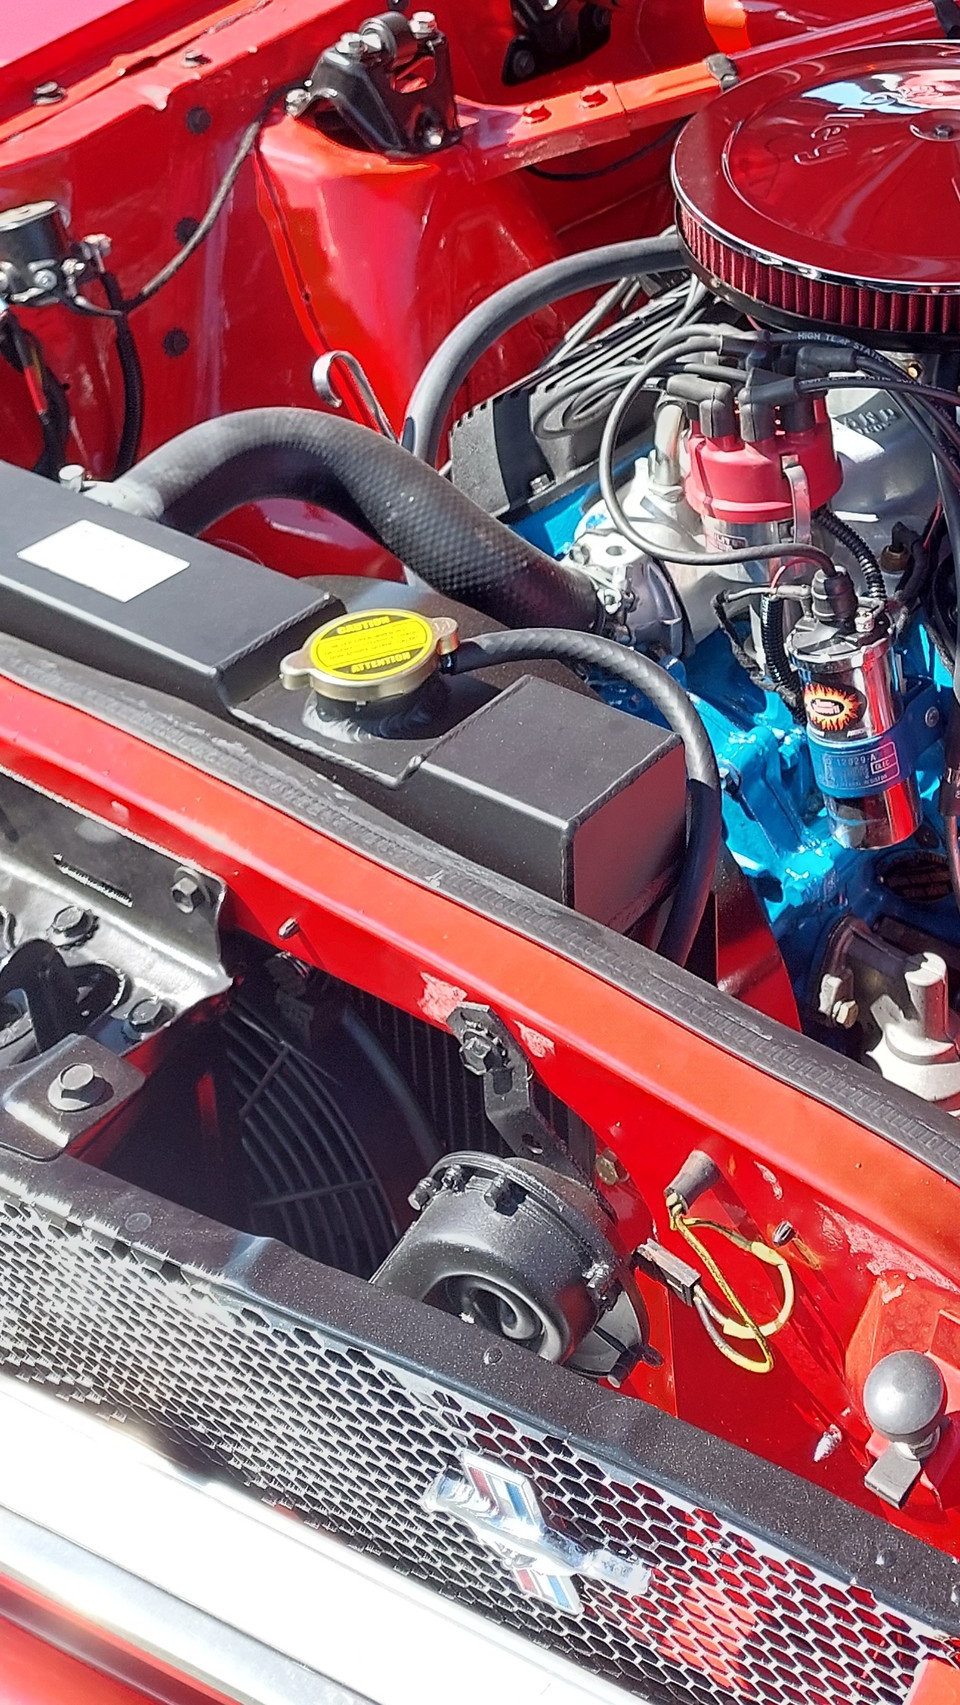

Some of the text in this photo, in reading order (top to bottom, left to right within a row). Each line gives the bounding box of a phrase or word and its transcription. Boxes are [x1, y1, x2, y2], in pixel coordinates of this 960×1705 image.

[797, 331, 821, 341] HIGH
[337, 616, 391, 634] CAUTION
[350, 651, 411, 674] ATTENTION
